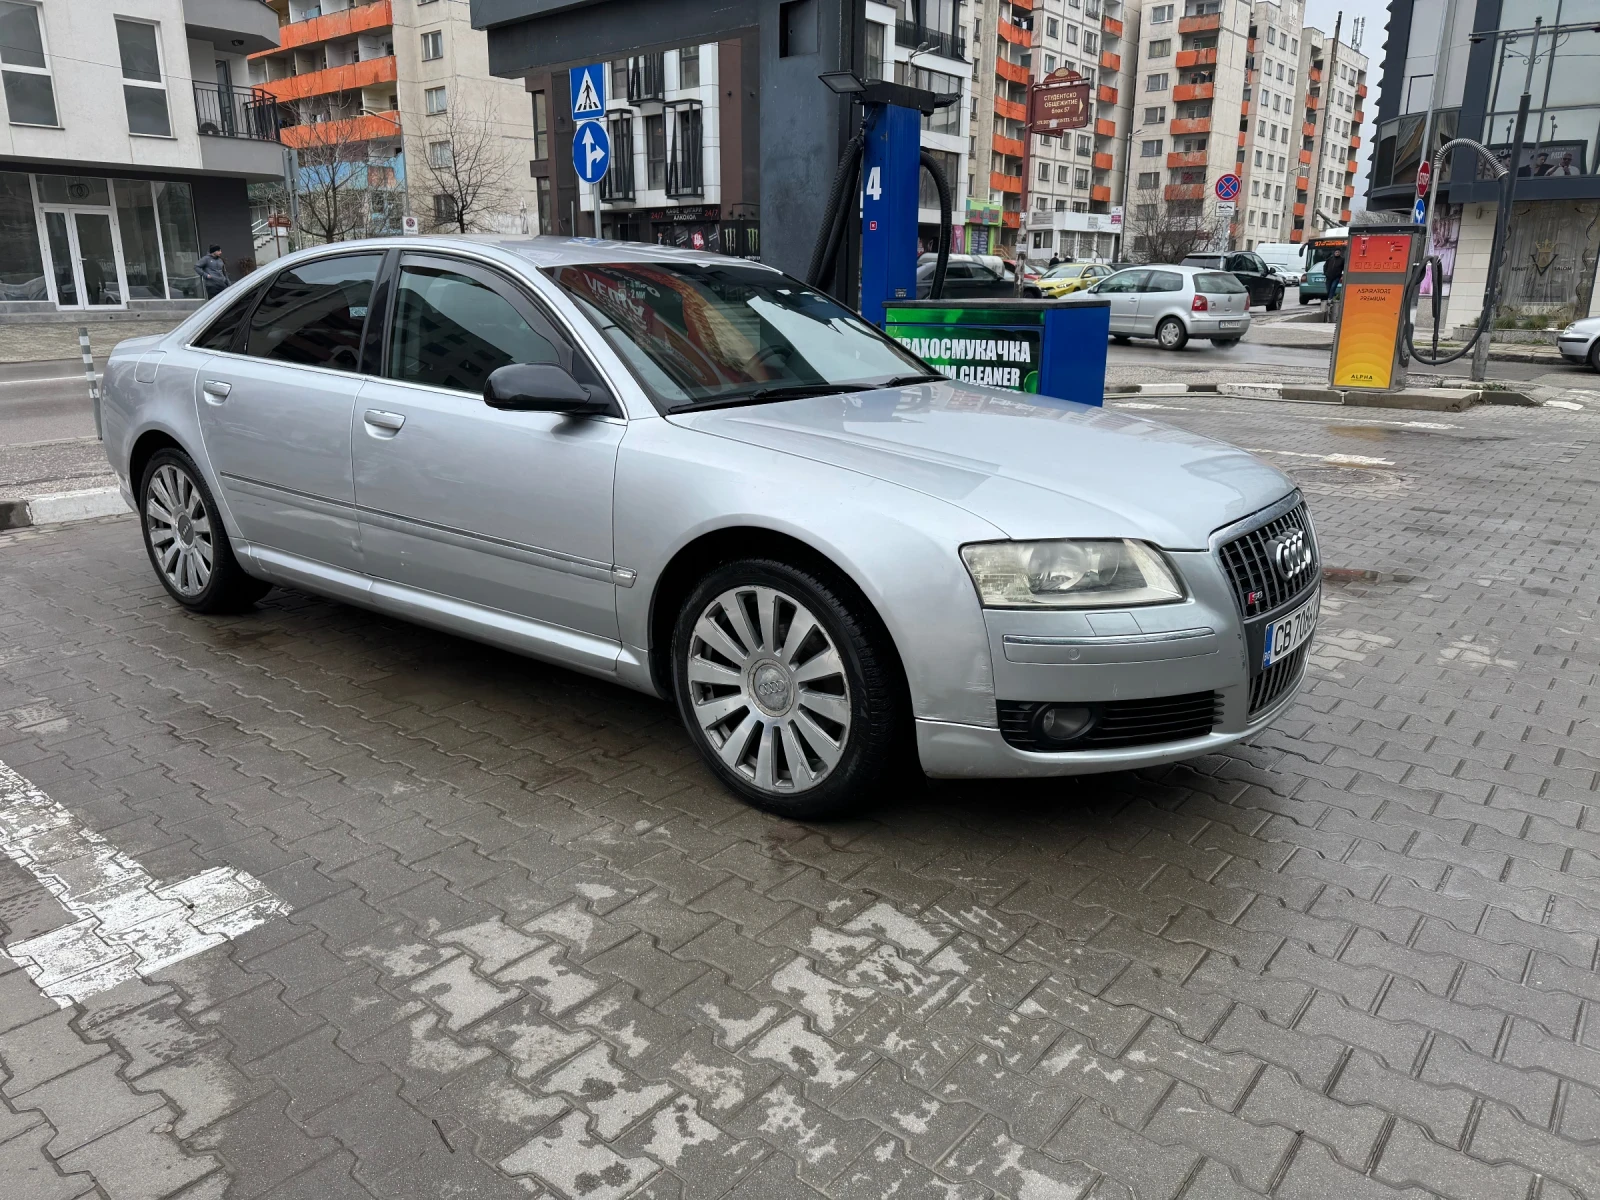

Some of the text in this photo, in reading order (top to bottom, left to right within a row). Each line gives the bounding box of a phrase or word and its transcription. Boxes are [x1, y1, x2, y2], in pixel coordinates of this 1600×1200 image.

[1044, 92, 1077, 101] СТУДЕНТСКО
[1044, 99, 1078, 108] ОБЩЕЖИТИЕ
[866, 166, 882, 200] 4
[1418, 172, 1430, 186] STOP
[651, 211, 664, 219] 24/7
[673, 213, 697, 221] АЛКОХОЛ
[704, 208, 719, 217] 24/7
[894, 337, 1031, 363] РАХОСМУКАЧКА
[960, 365, 1020, 387] CLEANER
[1274, 619, 1292, 656] CB
